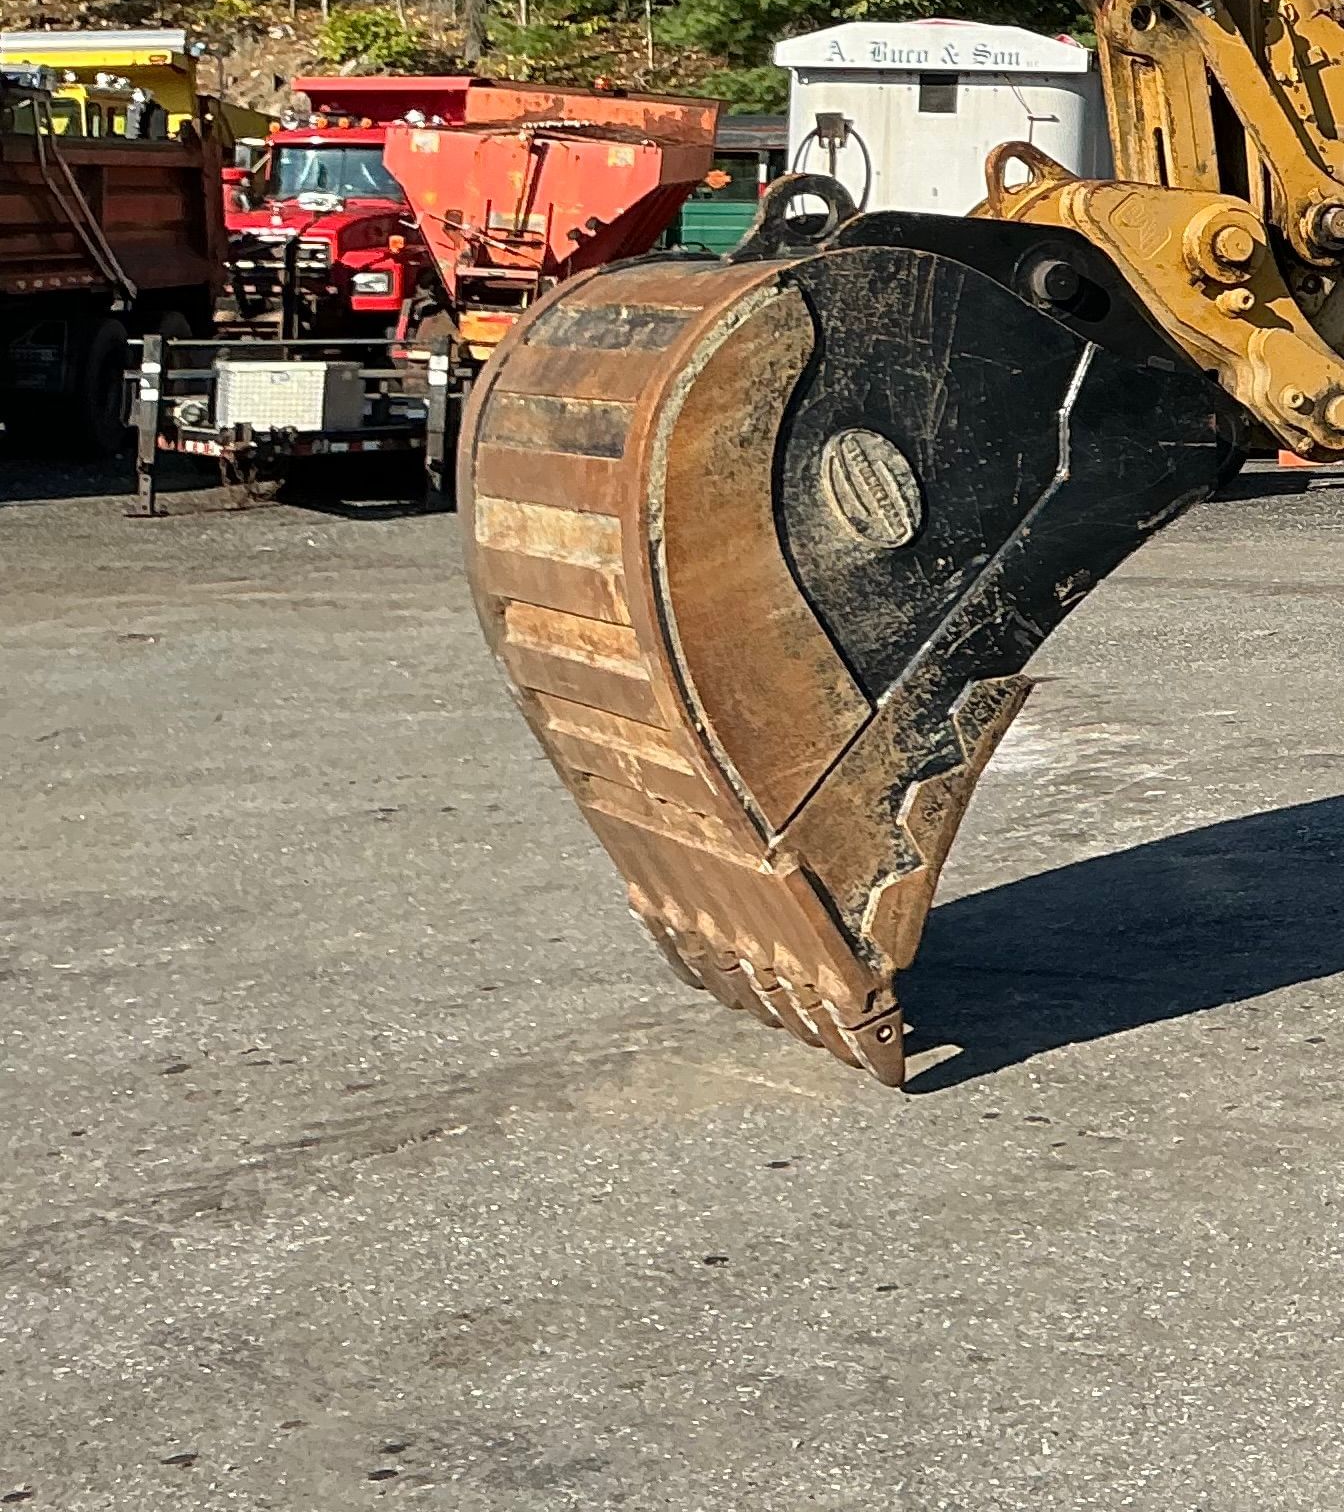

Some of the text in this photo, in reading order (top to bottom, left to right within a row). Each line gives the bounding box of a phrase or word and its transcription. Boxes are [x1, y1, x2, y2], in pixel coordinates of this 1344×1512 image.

[824, 40, 855, 63] A.
[941, 43, 959, 64] &
[972, 43, 1020, 66] Son
